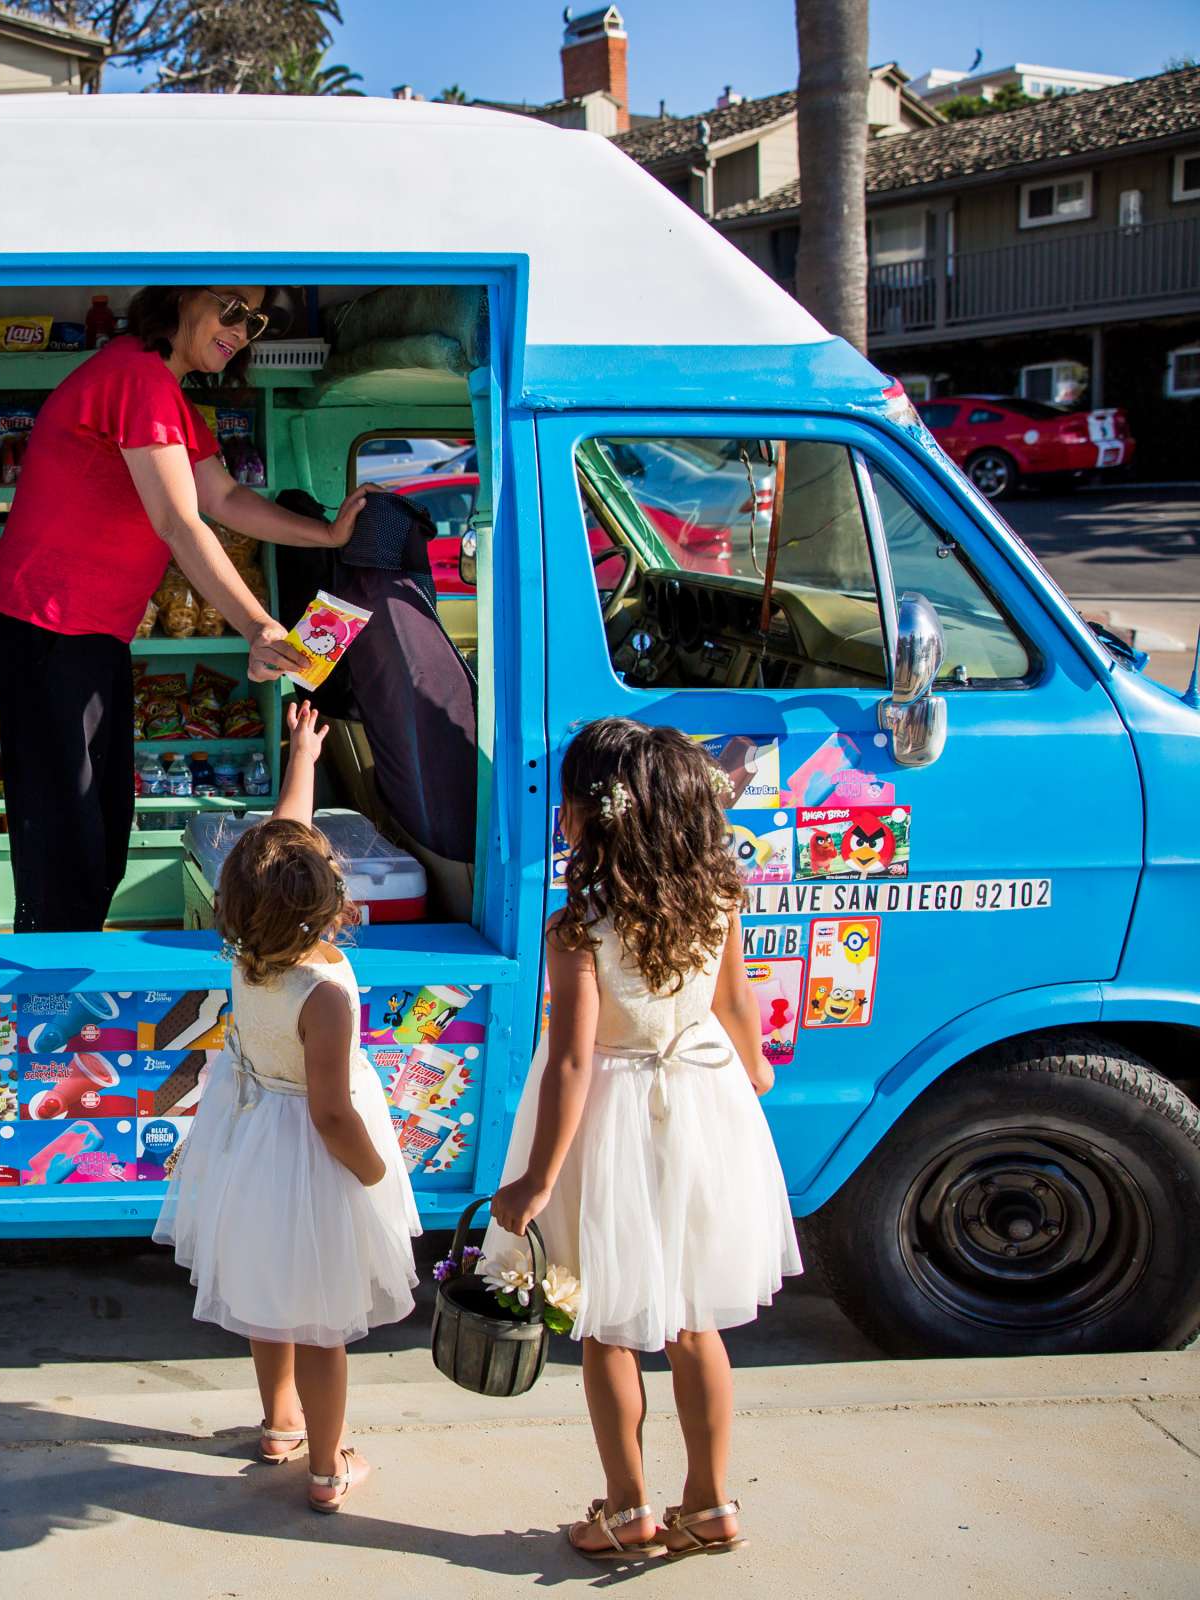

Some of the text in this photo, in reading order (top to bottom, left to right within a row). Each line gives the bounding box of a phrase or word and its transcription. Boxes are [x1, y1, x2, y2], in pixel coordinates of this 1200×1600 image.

[6, 326, 43, 343] Lay's
[802, 809, 850, 822] ANGRY BIRDS
[777, 885, 822, 913] AVE
[833, 884, 879, 910] SAN
[886, 884, 962, 910] DIEGO
[975, 880, 1050, 908] 92102
[816, 944, 832, 957] ME
[31, 993, 67, 1003] Two Ball
[31, 1062, 68, 1071] Two Ball
[375, 1059, 398, 1067] POP
[146, 1132, 175, 1144] RIBBON
